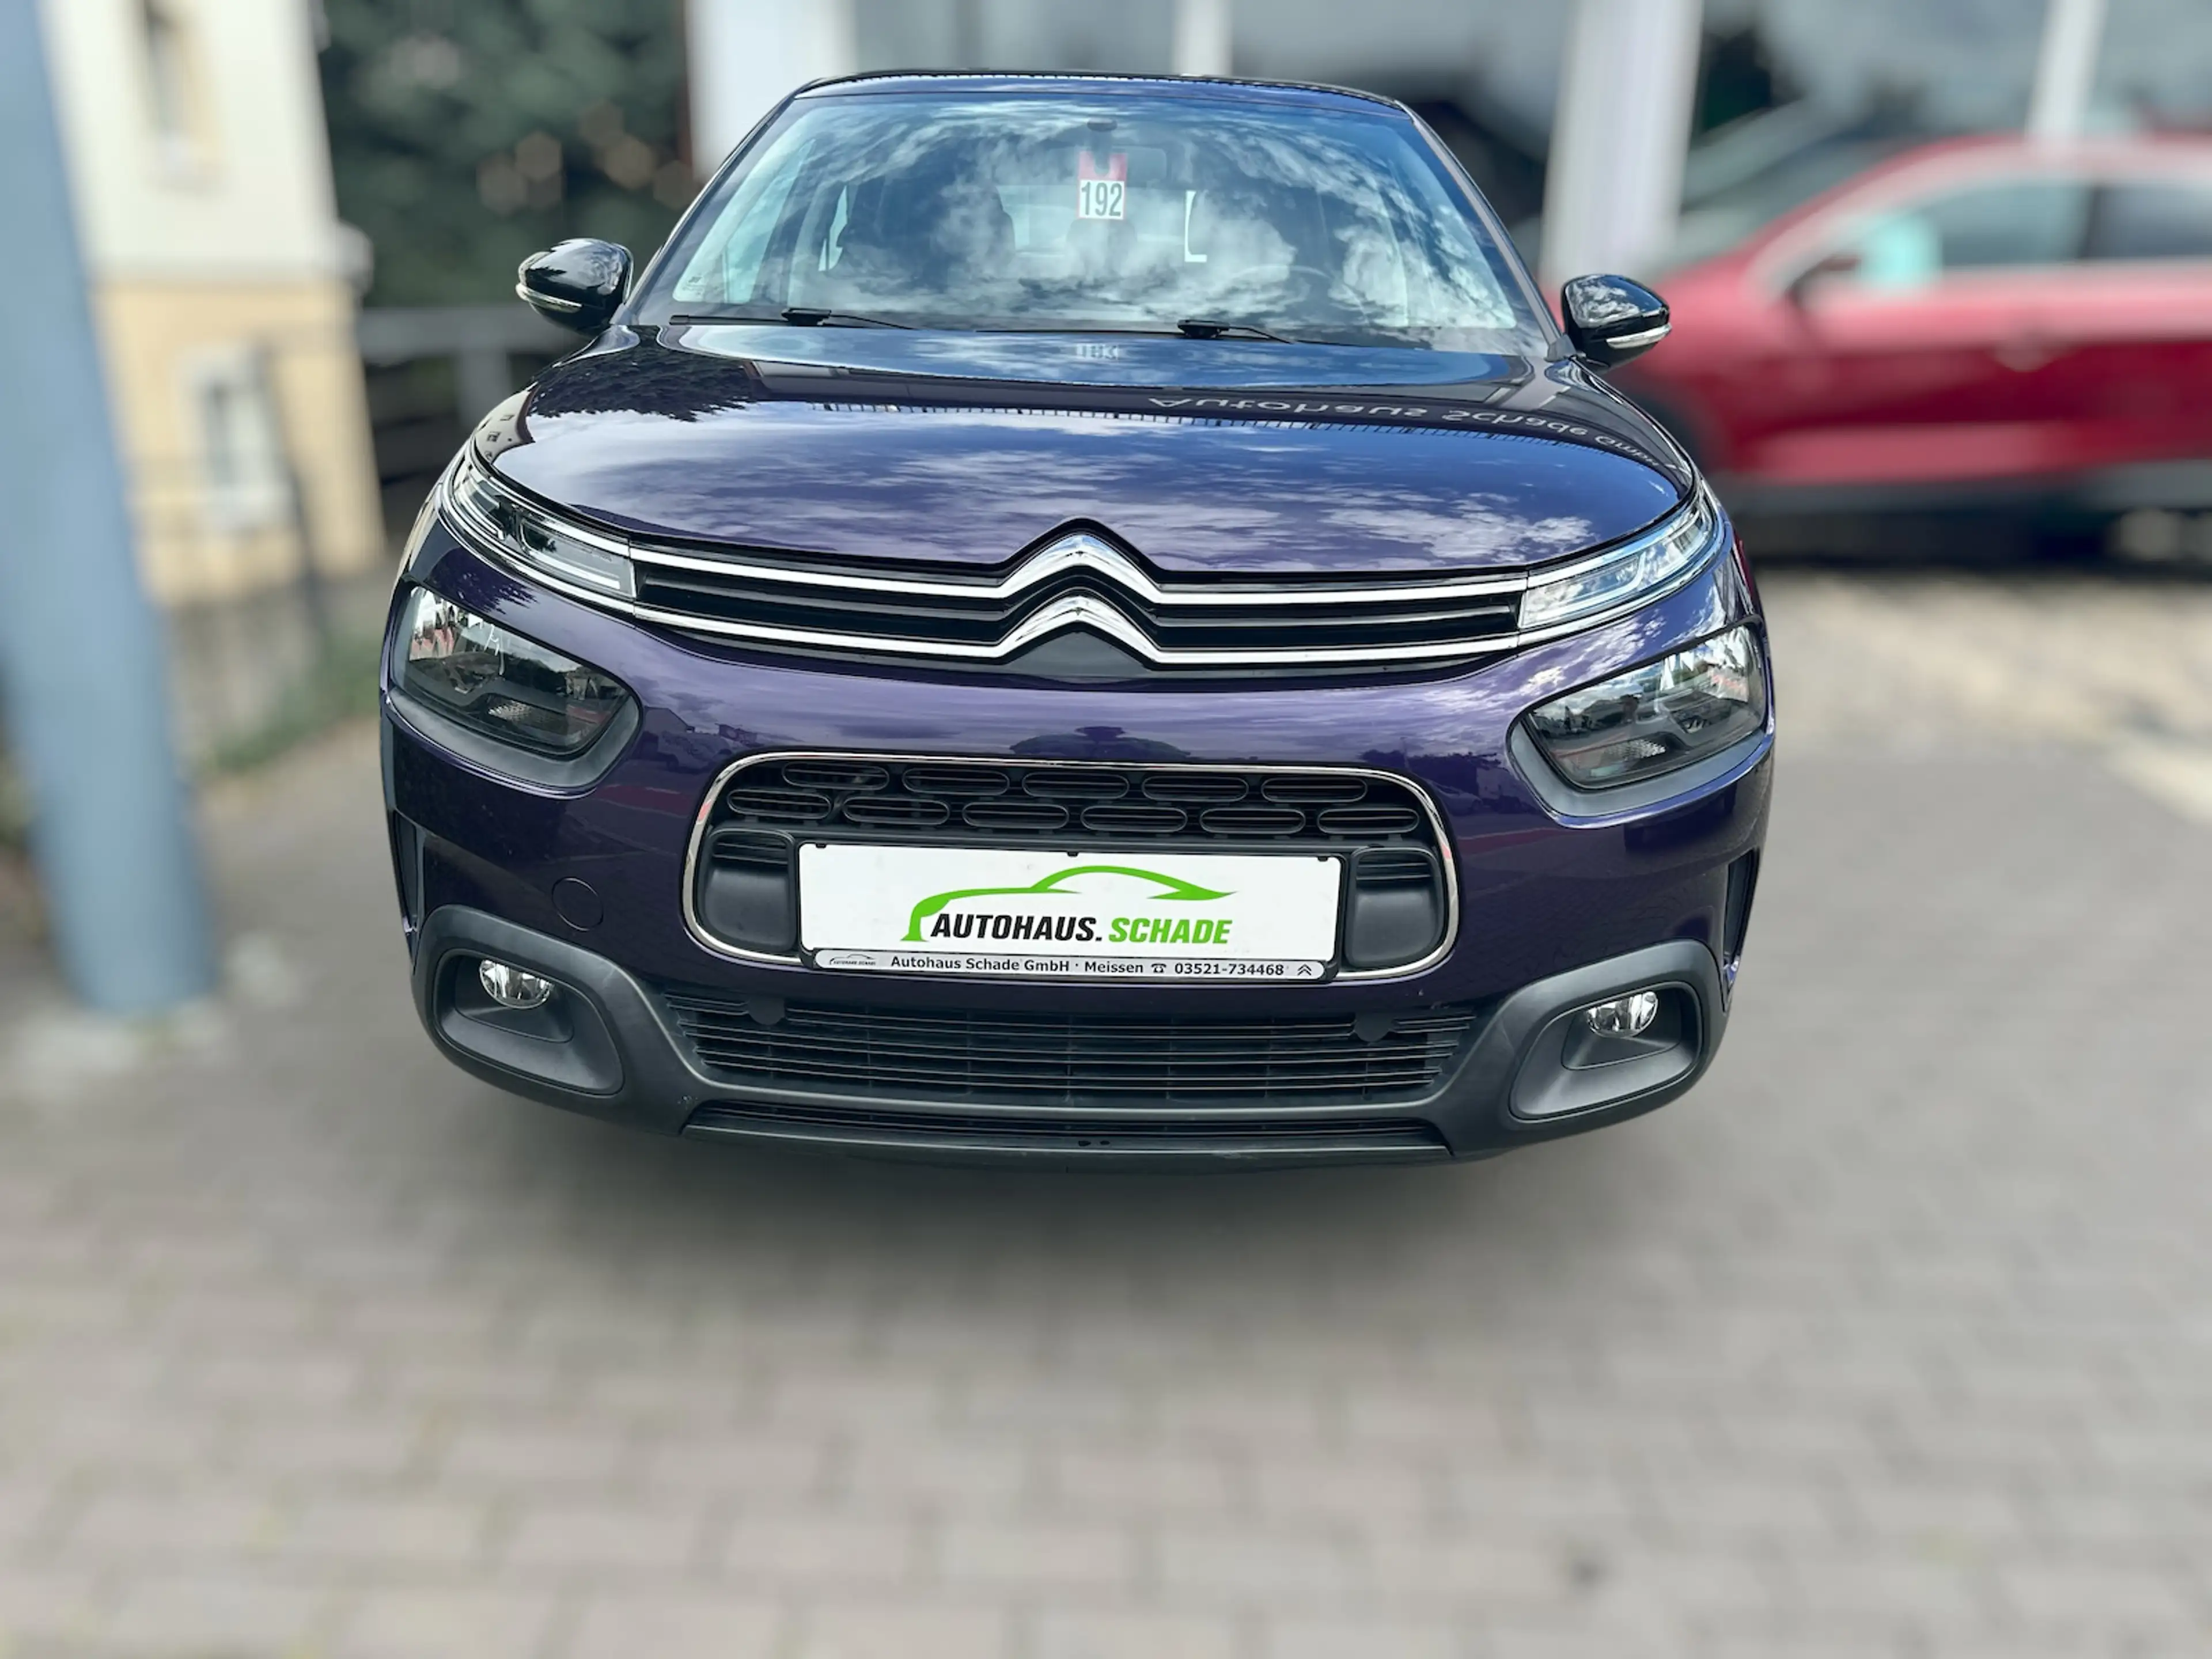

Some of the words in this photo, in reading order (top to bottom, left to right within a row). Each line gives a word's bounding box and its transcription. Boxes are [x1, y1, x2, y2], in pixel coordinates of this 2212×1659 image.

[1081, 181, 1122, 216] 192
[930, 914, 1102, 942] AUTOHAUS.
[1109, 918, 1232, 944] SCHADE
[891, 955, 961, 970] Autohaus
[965, 957, 1020, 971] Schade
[1024, 960, 1070, 972] GmbH
[1085, 961, 1143, 974] Meissen
[1175, 963, 1285, 976] 03521-734468
